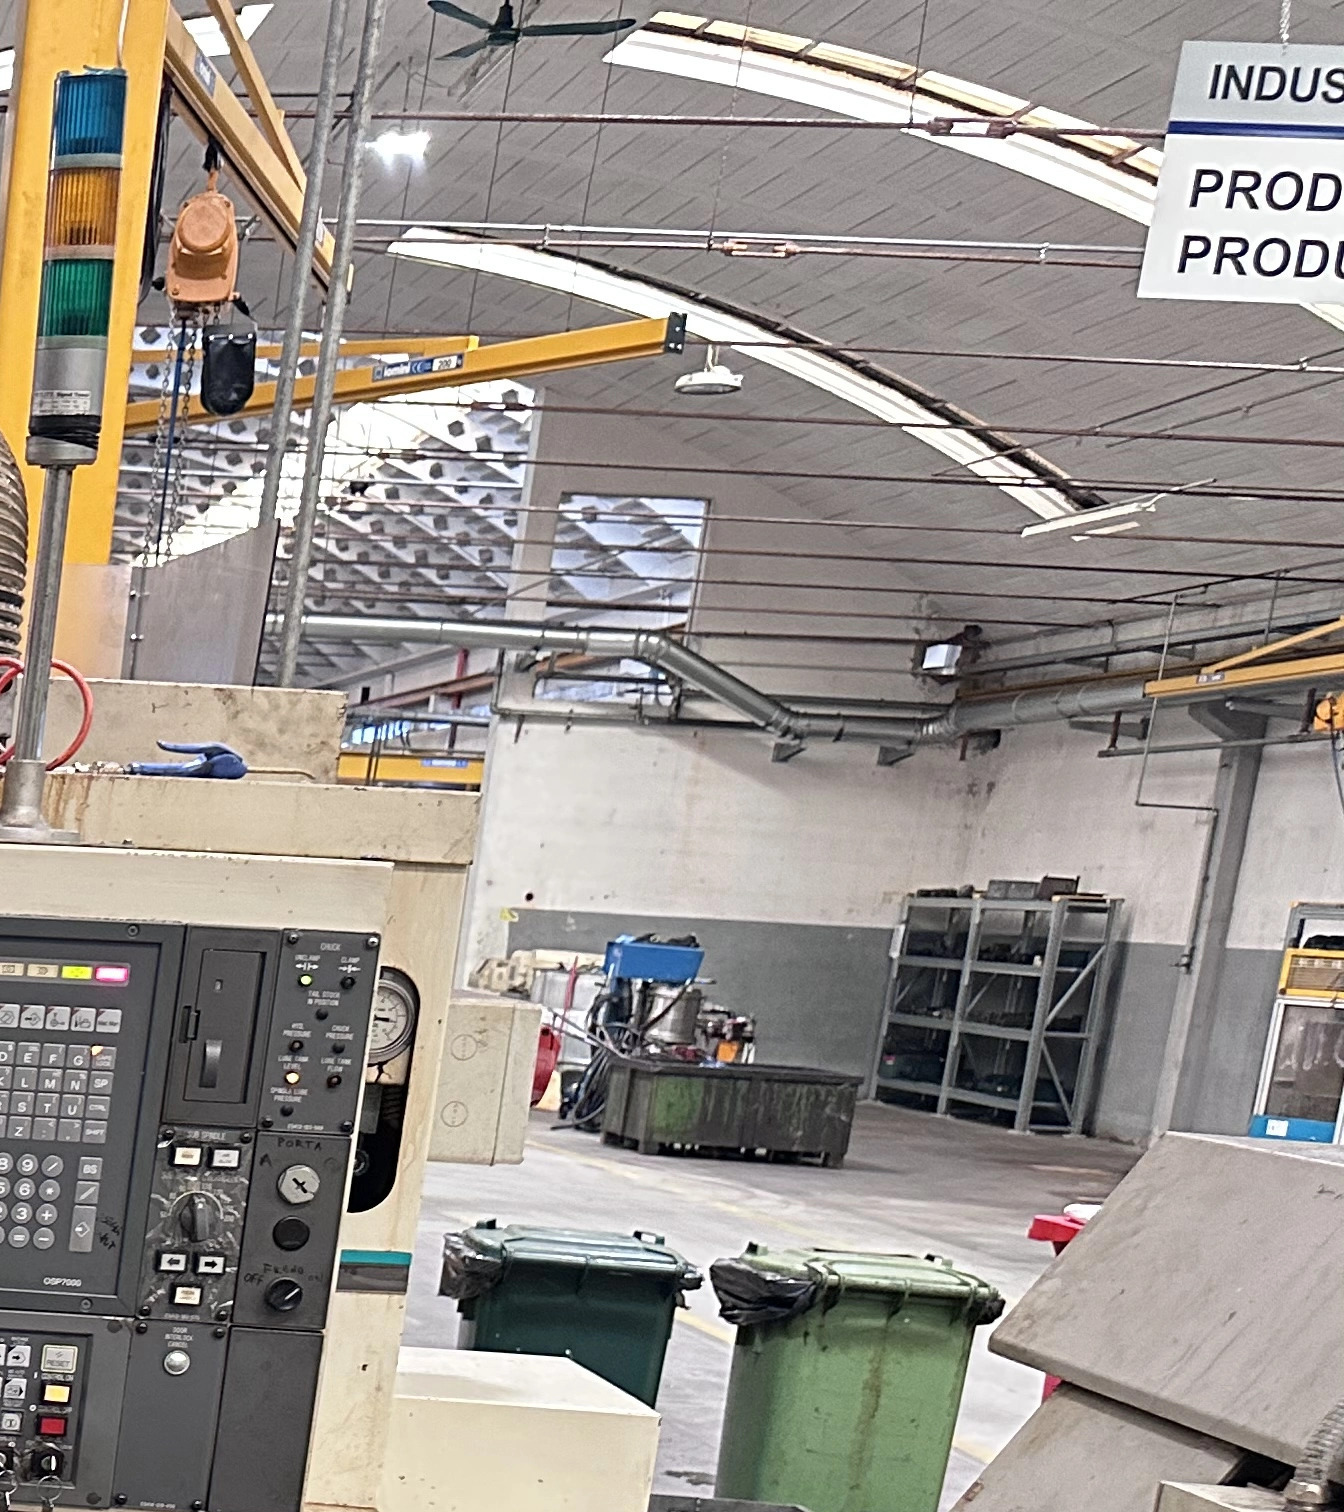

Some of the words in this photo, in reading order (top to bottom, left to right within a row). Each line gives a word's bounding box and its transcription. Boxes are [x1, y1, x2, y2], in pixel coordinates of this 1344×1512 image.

[1209, 64, 1344, 103] INDUS
[1189, 168, 1343, 212] PROD
[23, 1052, 32, 1063] E
[48, 1054, 57, 1065] F
[73, 1055, 84, 1066] G
[21, 1077, 29, 1087] L
[44, 1078, 56, 1089] M
[70, 1080, 81, 1091] N
[93, 1078, 108, 1089] SP
[17, 1101, 27, 1112] S
[43, 1103, 52, 1113] T
[67, 1104, 77, 1115] U
[14, 1126, 23, 1136] Z
[277, 1137, 322, 1150] PORTA
[22, 1159, 34, 1171] 9
[82, 1164, 98, 1174] BS
[19, 1183, 30, 1195] 6
[16, 1207, 27, 1220] 3
